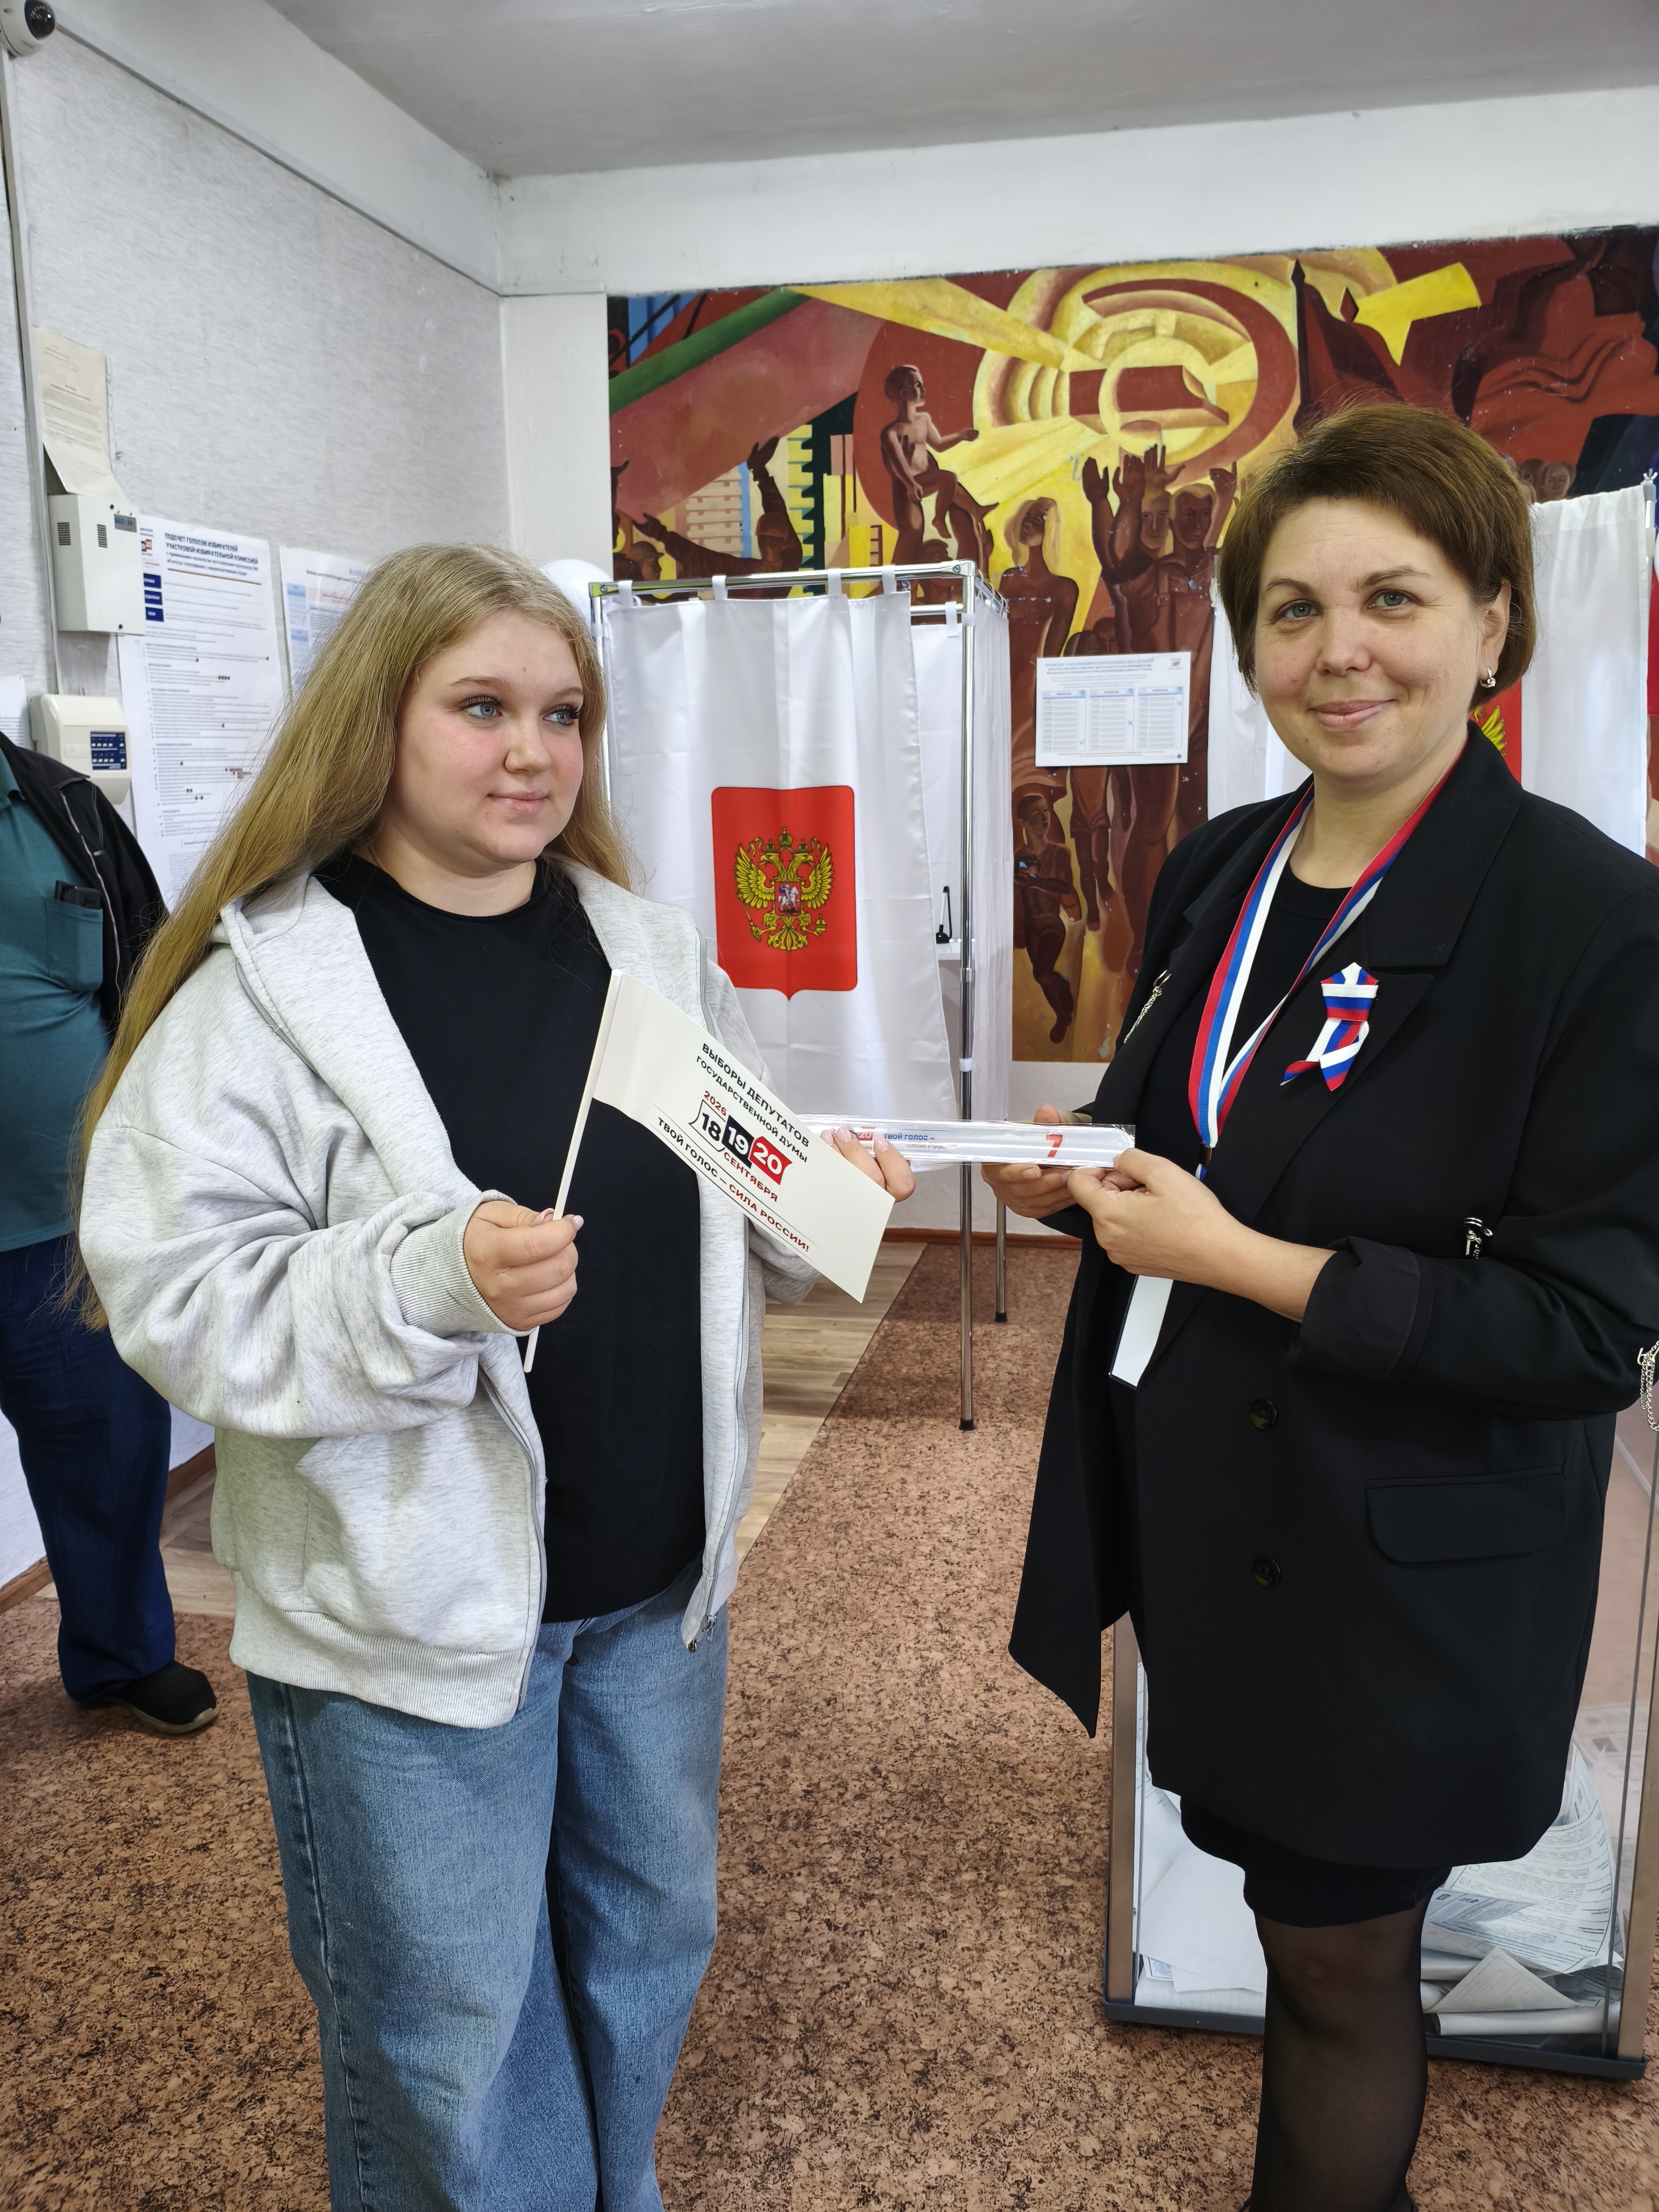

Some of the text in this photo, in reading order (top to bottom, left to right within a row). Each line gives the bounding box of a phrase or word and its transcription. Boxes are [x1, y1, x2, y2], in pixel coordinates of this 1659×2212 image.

[696, 1056, 807, 1163] ГОСУДАРСТВЕННОЙ ДУМЫ
[702, 1043, 809, 1147] ВЫБОРЫ ДЕПУТАТОВ
[704, 1090, 726, 1116] 2026
[658, 1117, 684, 1143] ТВОЙ
[685, 1143, 718, 1177] ГОЛОС
[729, 1184, 757, 1212] СИЛА
[760, 1210, 809, 1252] РОССИИ!
[702, 1112, 783, 1175] 18 19 20
[724, 1152, 778, 1202] СЕНТЯБРЯ
